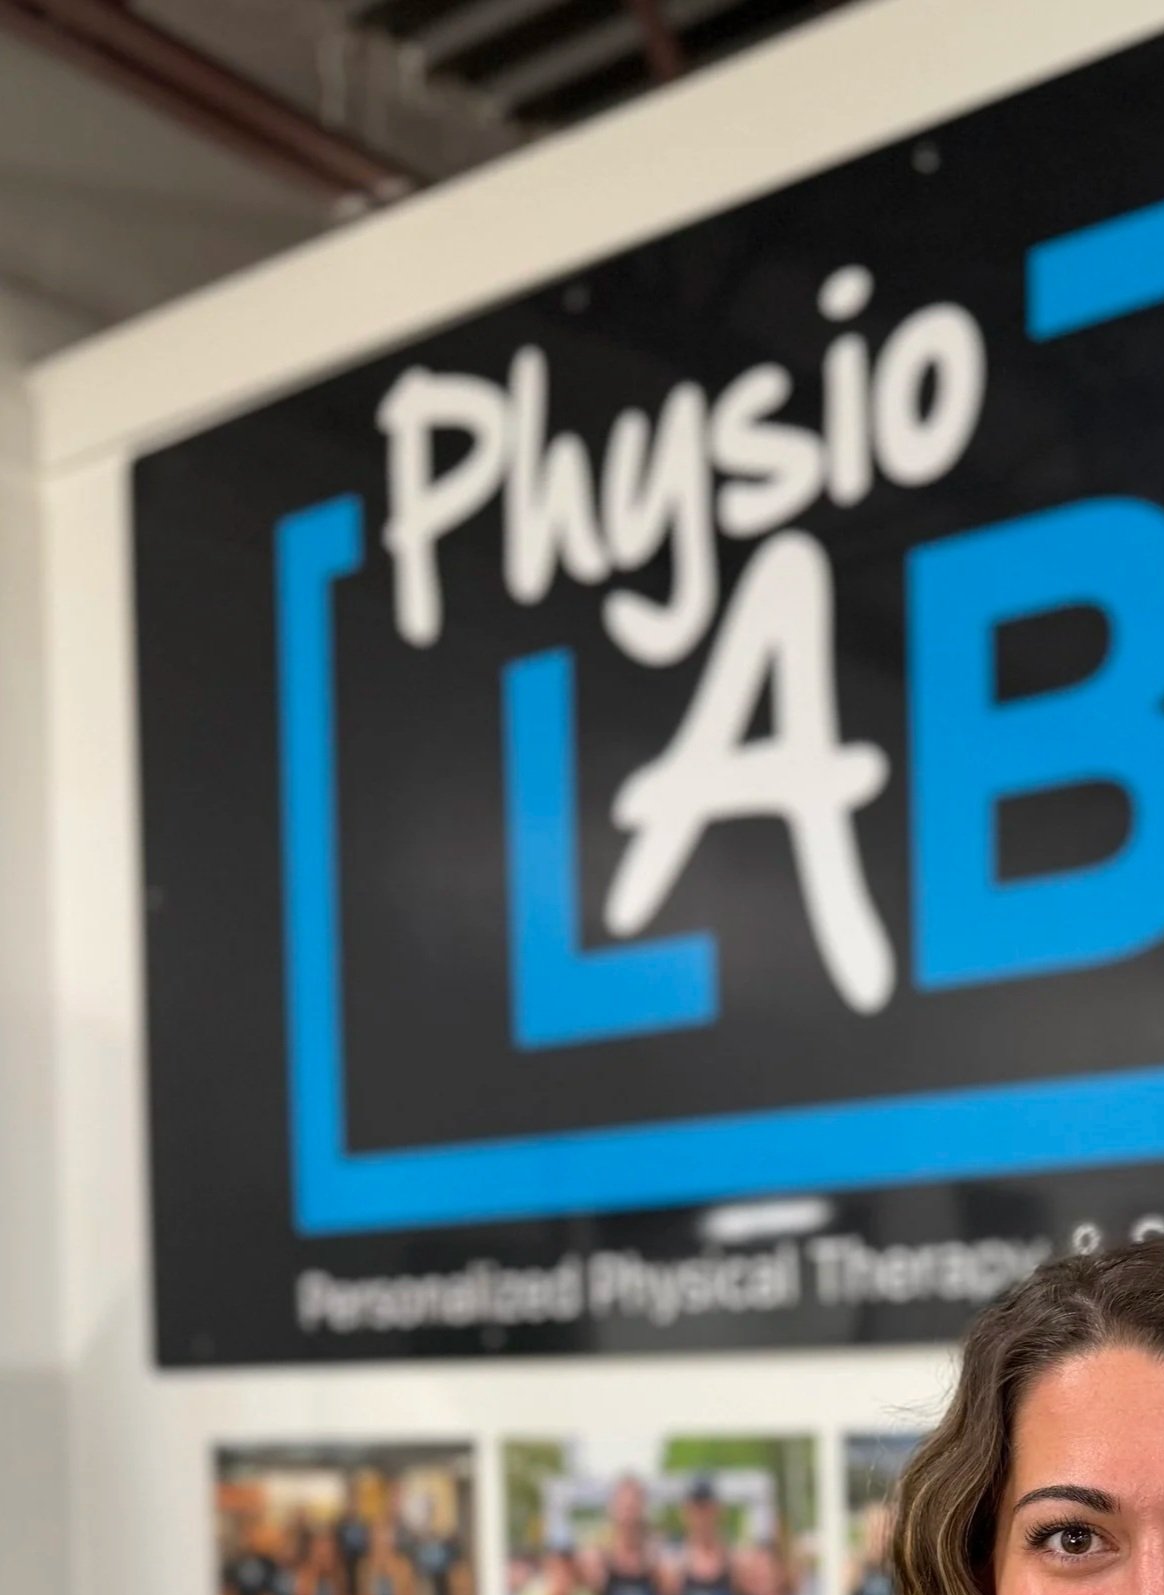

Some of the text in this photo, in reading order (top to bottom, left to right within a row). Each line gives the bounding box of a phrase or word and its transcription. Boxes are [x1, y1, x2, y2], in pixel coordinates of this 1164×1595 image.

[376, 263, 988, 667] Physio
[296, 1257, 583, 1333] Personalized
[587, 1239, 799, 1326] Physical
